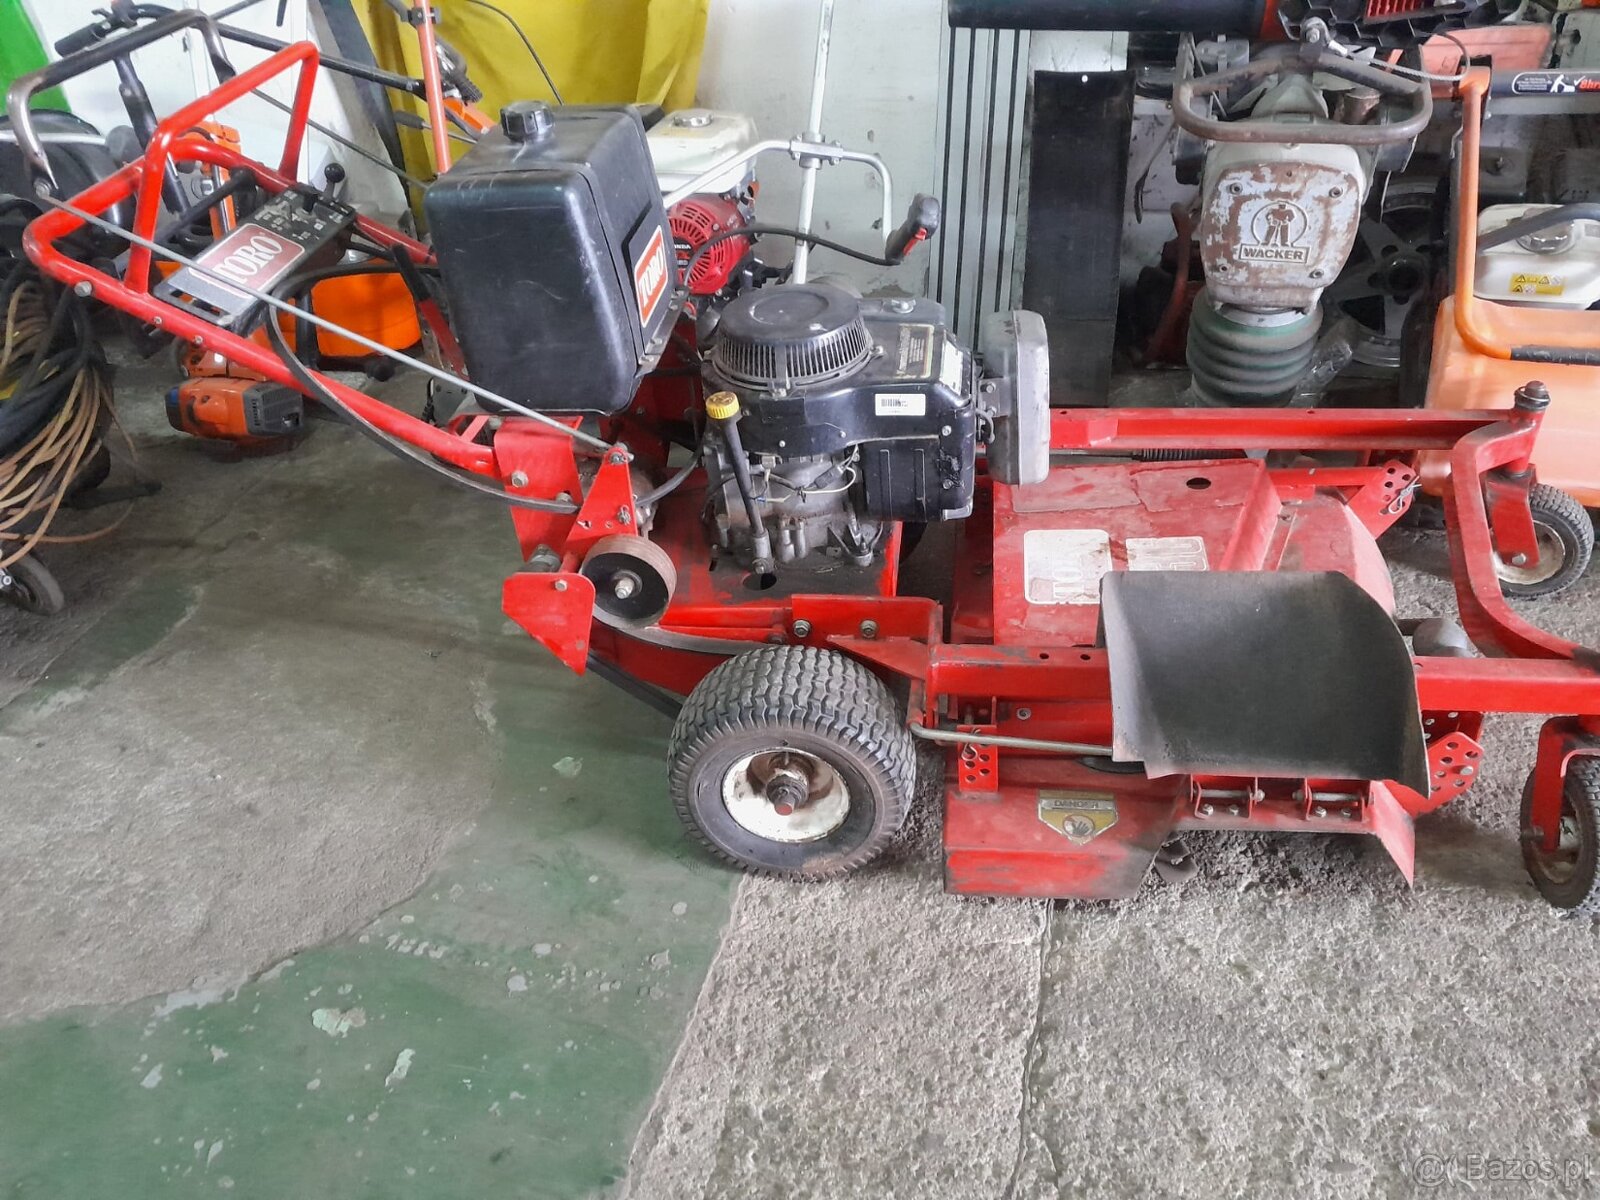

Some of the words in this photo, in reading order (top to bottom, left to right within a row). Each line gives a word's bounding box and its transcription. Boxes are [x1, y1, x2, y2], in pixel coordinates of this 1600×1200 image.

[212, 235, 283, 285] TORO
[638, 245, 664, 308] TORO
[1244, 247, 1304, 260] WACKER
